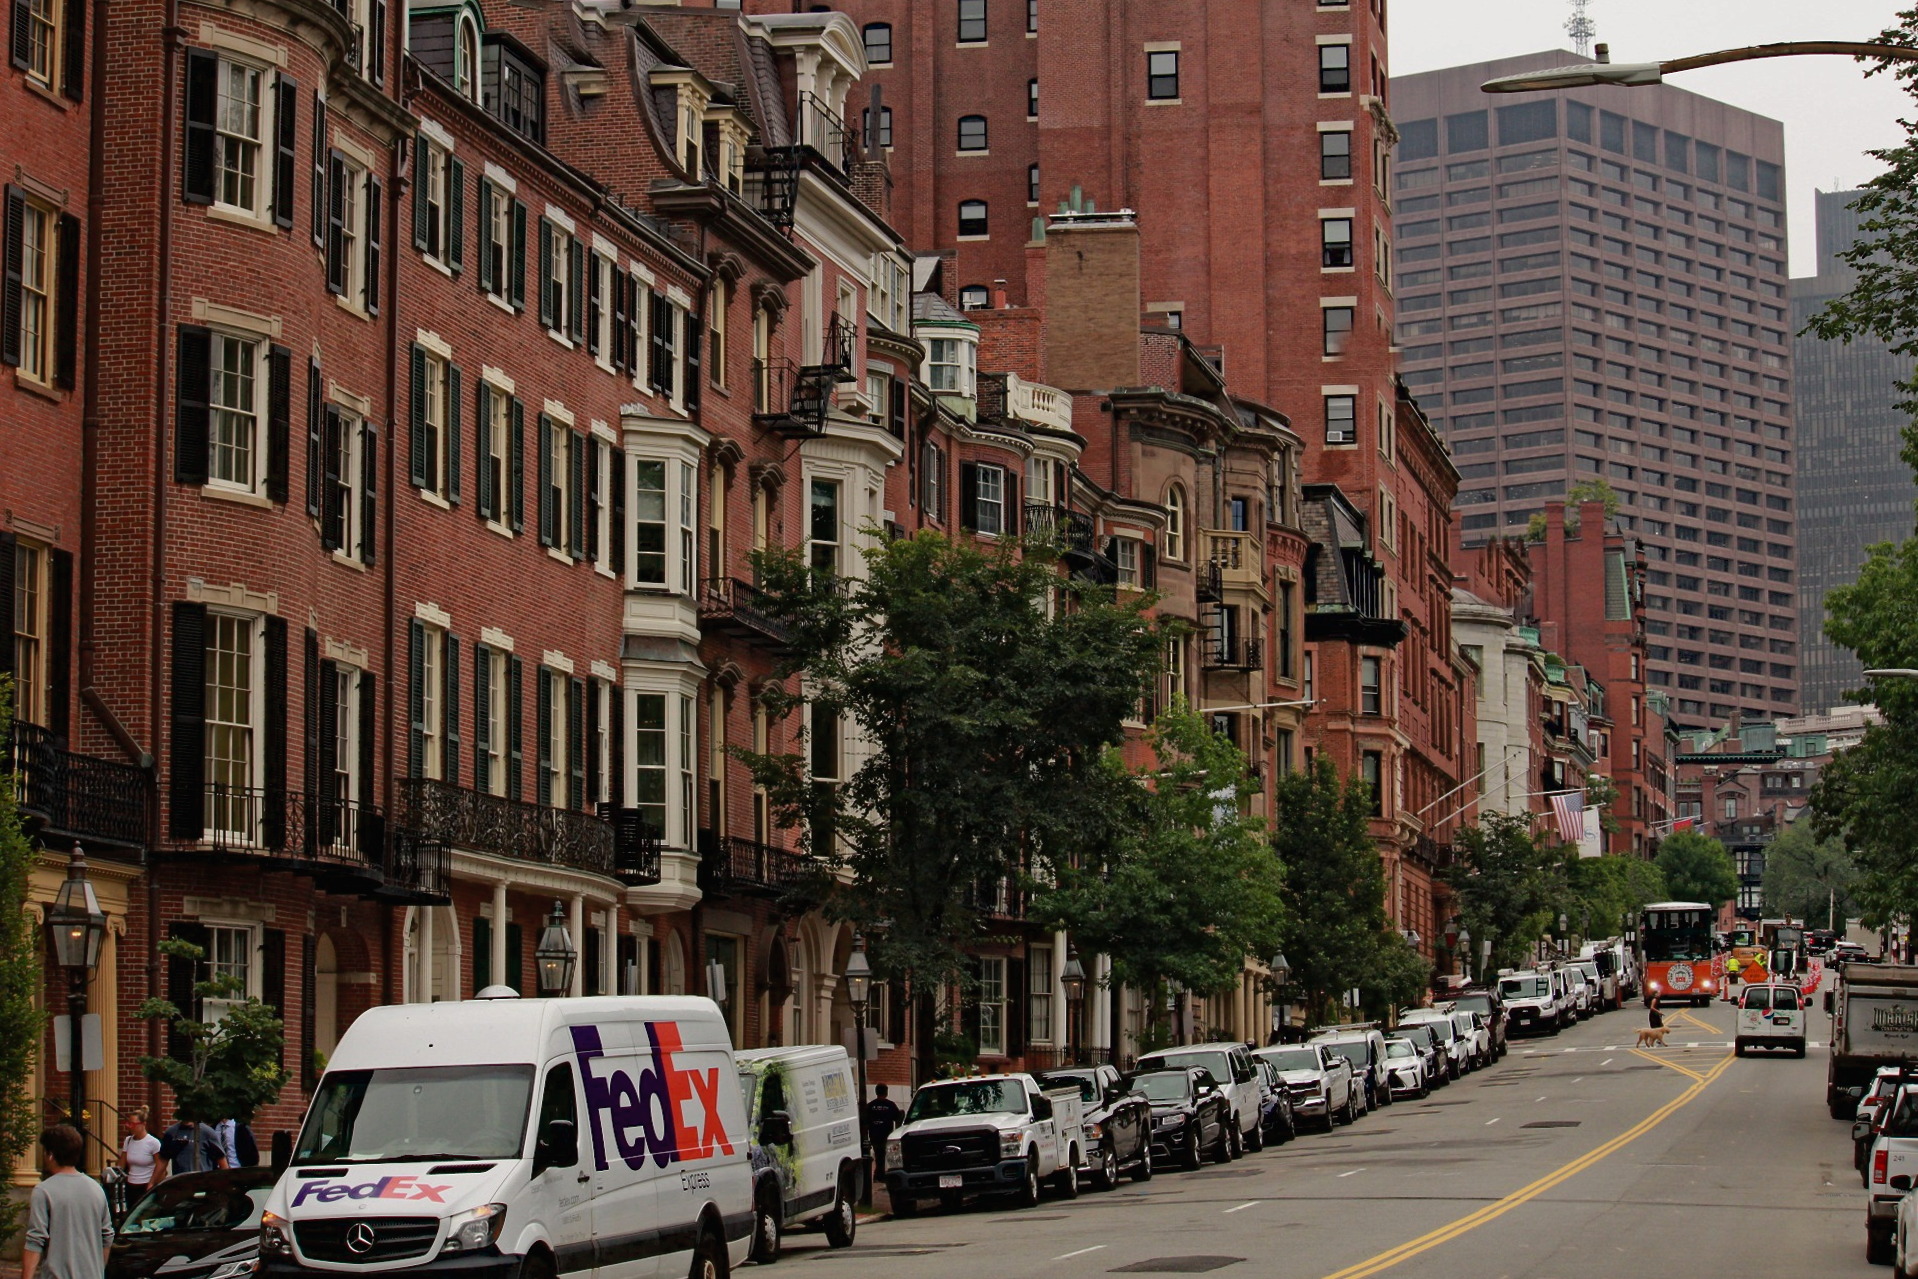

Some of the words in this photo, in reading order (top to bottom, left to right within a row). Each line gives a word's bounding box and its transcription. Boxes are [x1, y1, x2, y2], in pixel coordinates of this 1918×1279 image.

[570, 1021, 735, 1172] FedEx
[290, 1175, 453, 1208] FedEx
[680, 1169, 711, 1195] Express
